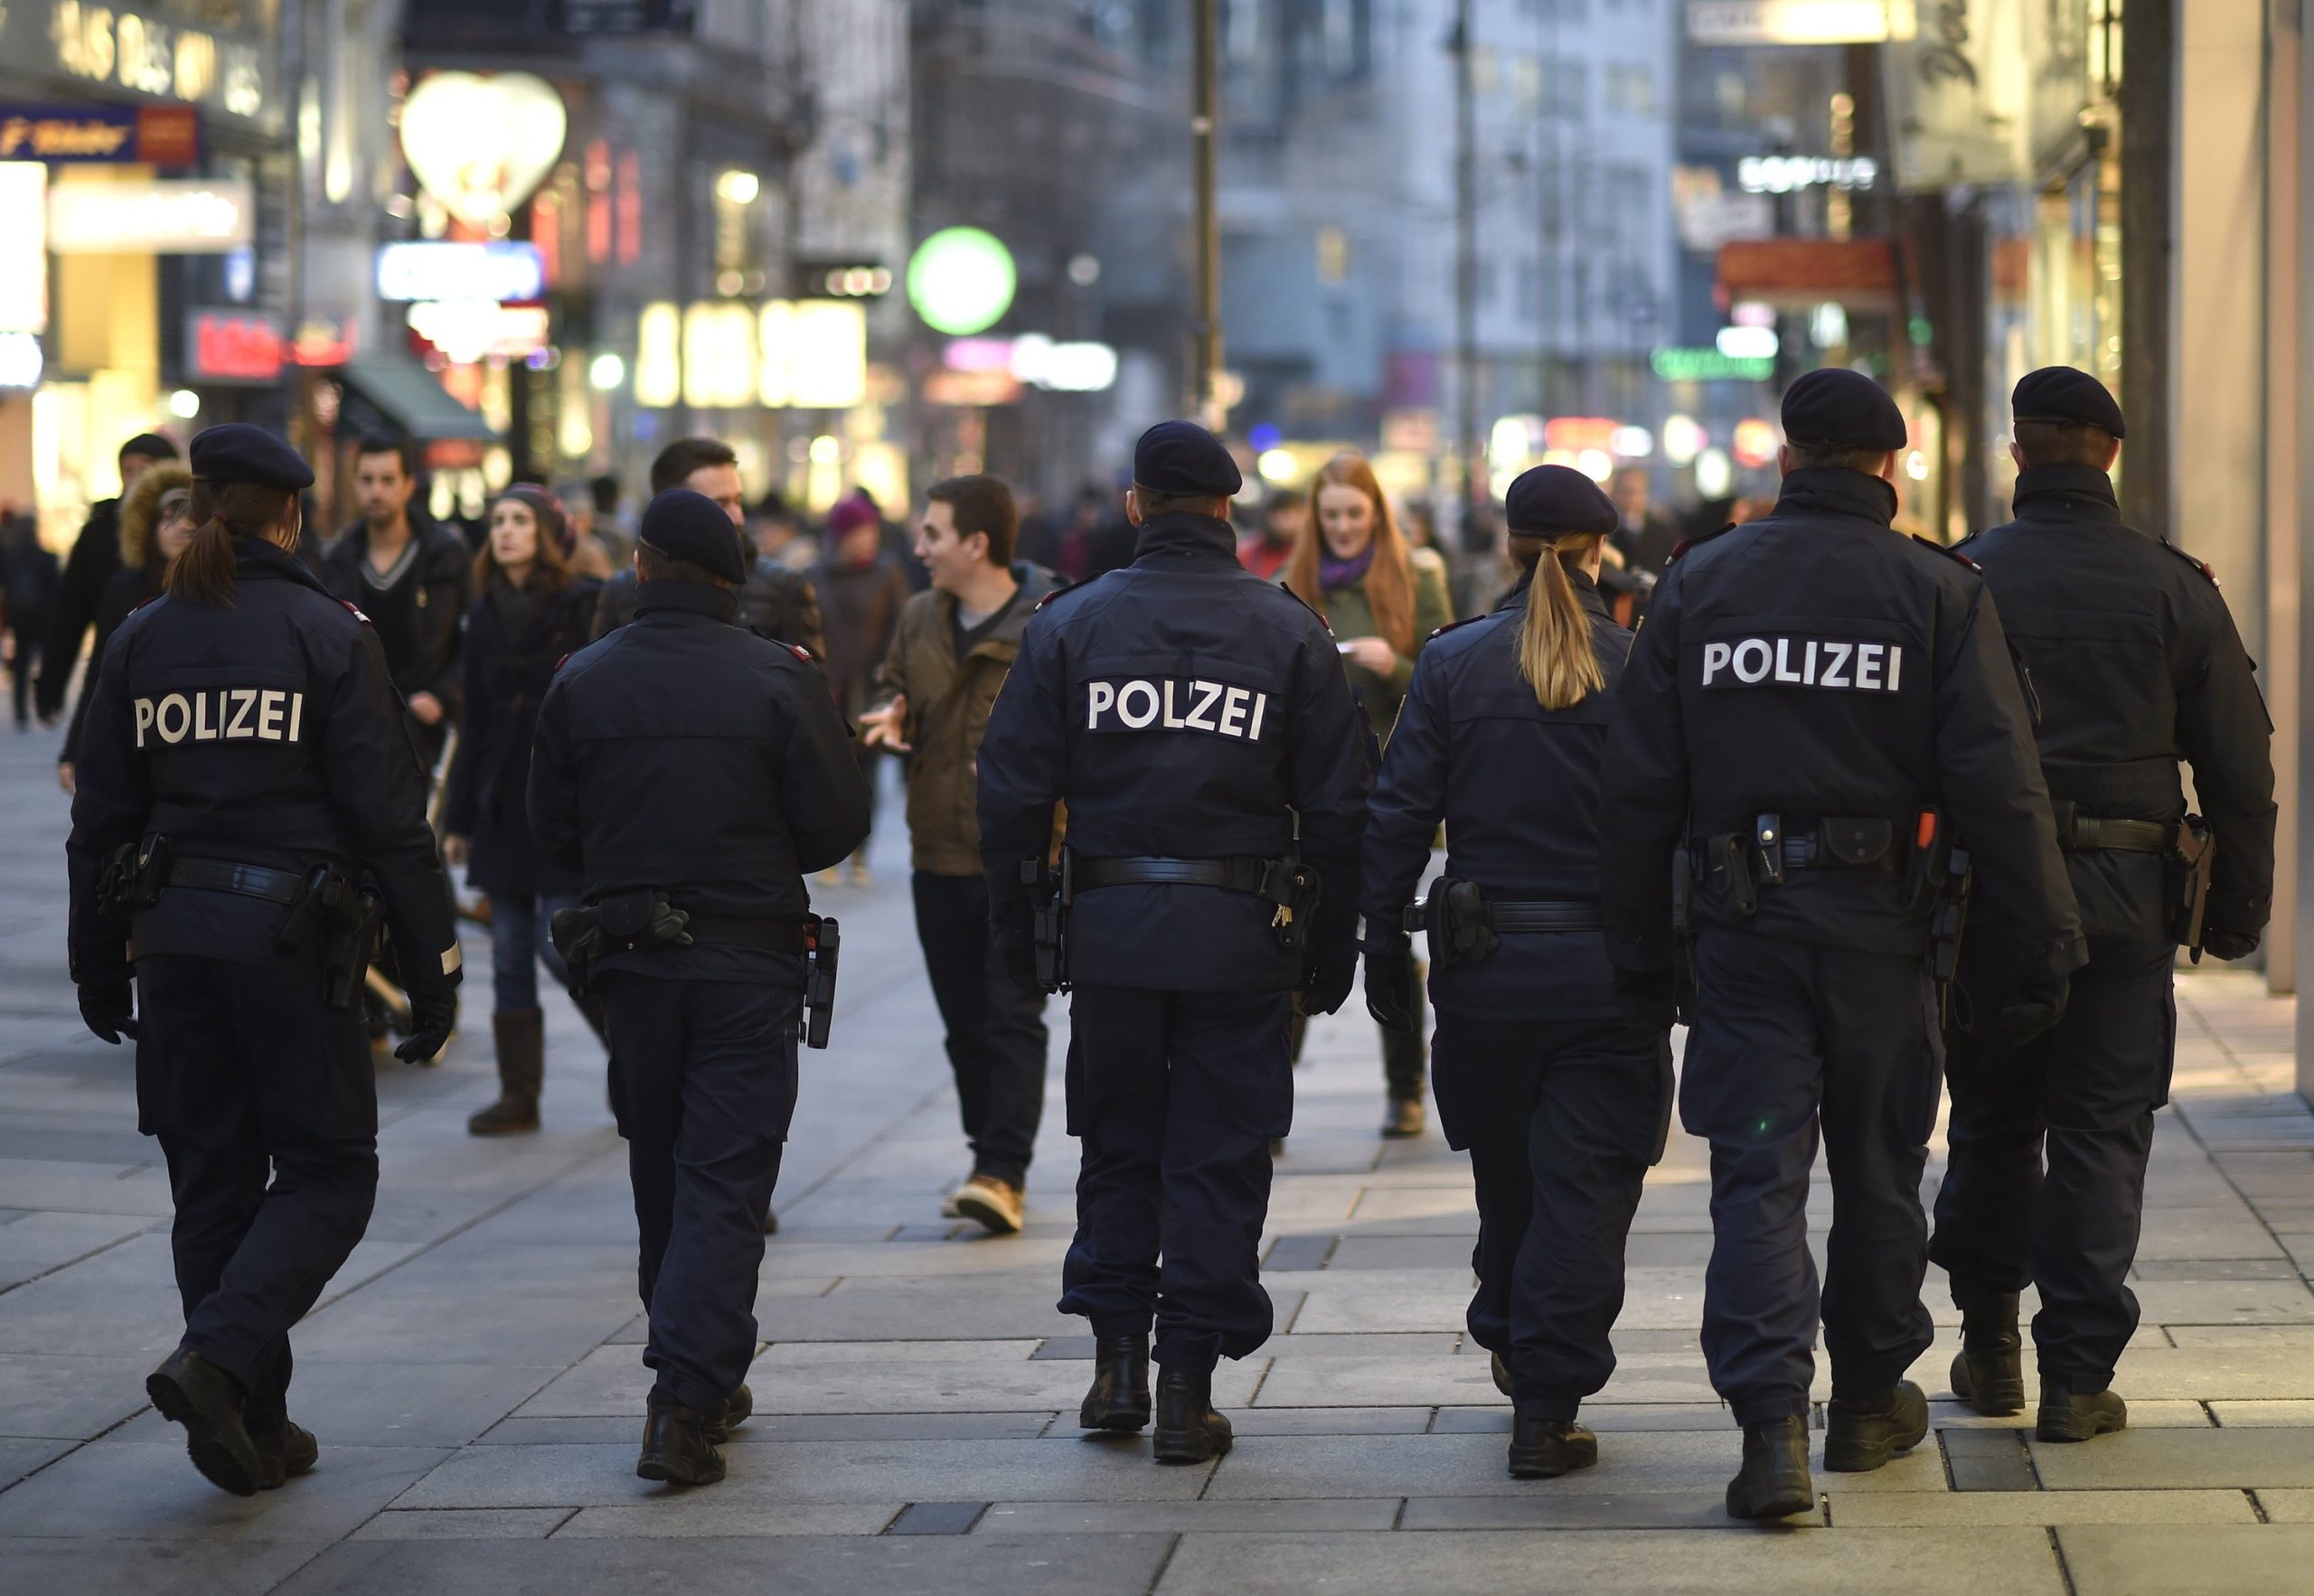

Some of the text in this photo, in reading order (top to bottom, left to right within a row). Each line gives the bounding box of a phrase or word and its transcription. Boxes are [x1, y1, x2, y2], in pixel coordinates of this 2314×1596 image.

[1702, 638, 1902, 691] POLIZEI
[134, 690, 303, 747] POLIZEI
[1088, 680, 1266, 741] POLZEI
